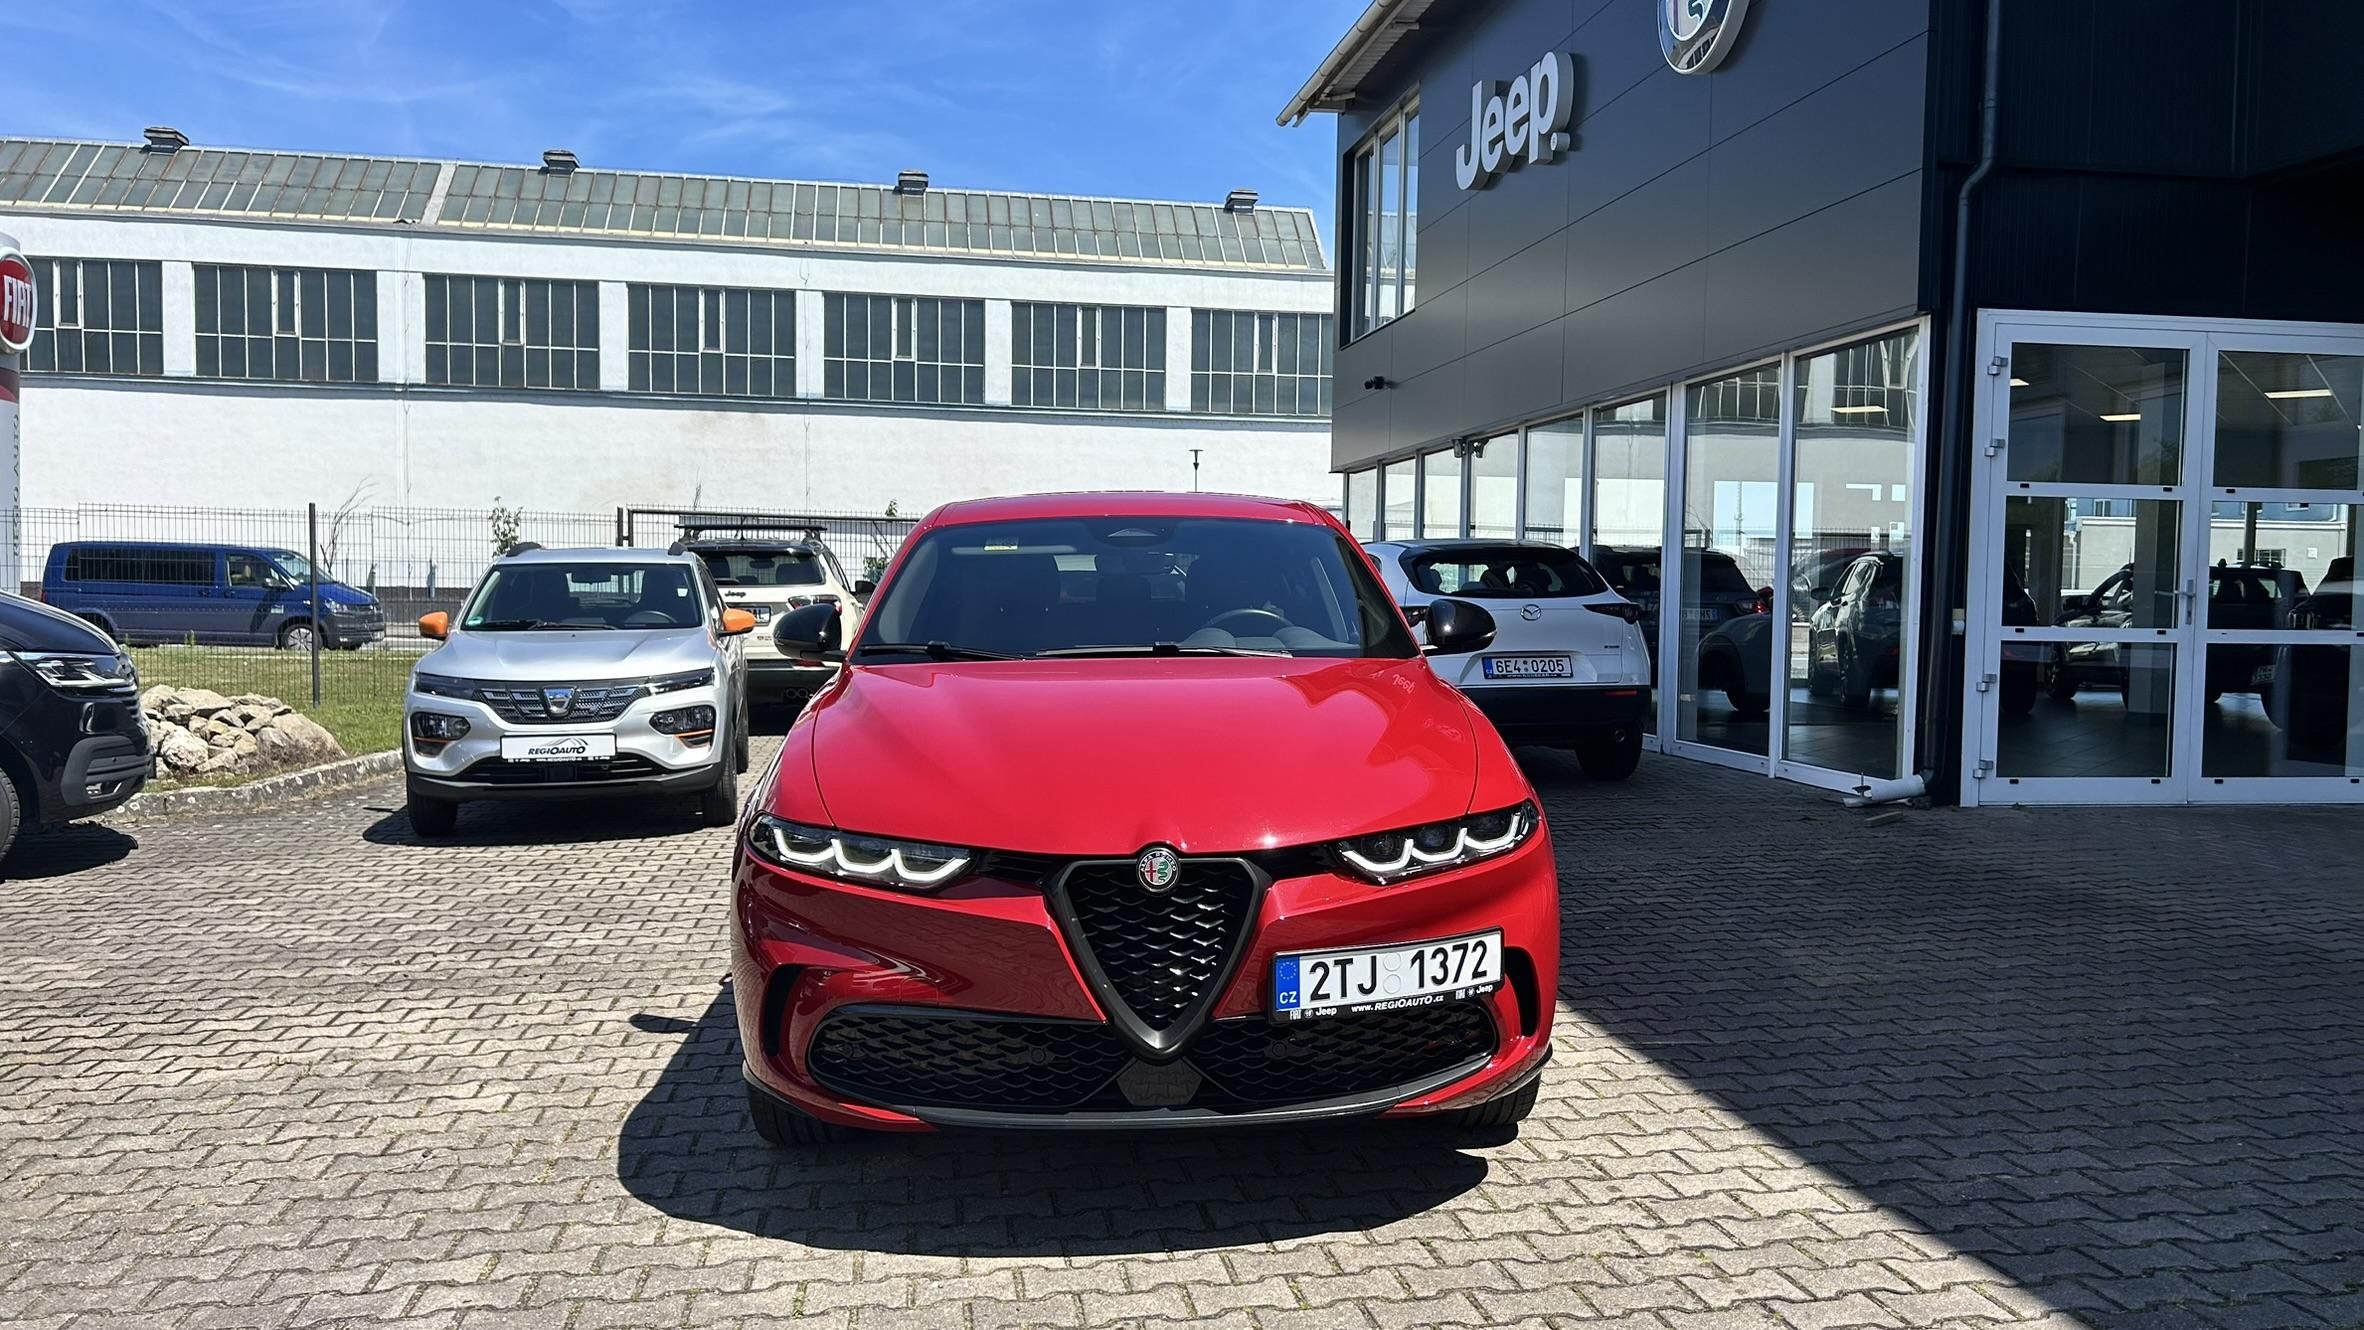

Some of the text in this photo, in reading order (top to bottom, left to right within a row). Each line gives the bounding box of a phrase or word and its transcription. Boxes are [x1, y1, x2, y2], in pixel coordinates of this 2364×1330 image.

[1456, 51, 1559, 190] Jeep
[3, 274, 32, 328] FIAT
[1495, 660, 1521, 673] 6E4
[1531, 659, 1565, 673] 0205
[528, 746, 586, 755] REGIOAUTO
[1309, 940, 1488, 1002] 2TJ 1372
[1279, 991, 1297, 1004] CZ
[1315, 1007, 1337, 1016] Jeep
[1476, 984, 1493, 994] Jeep
